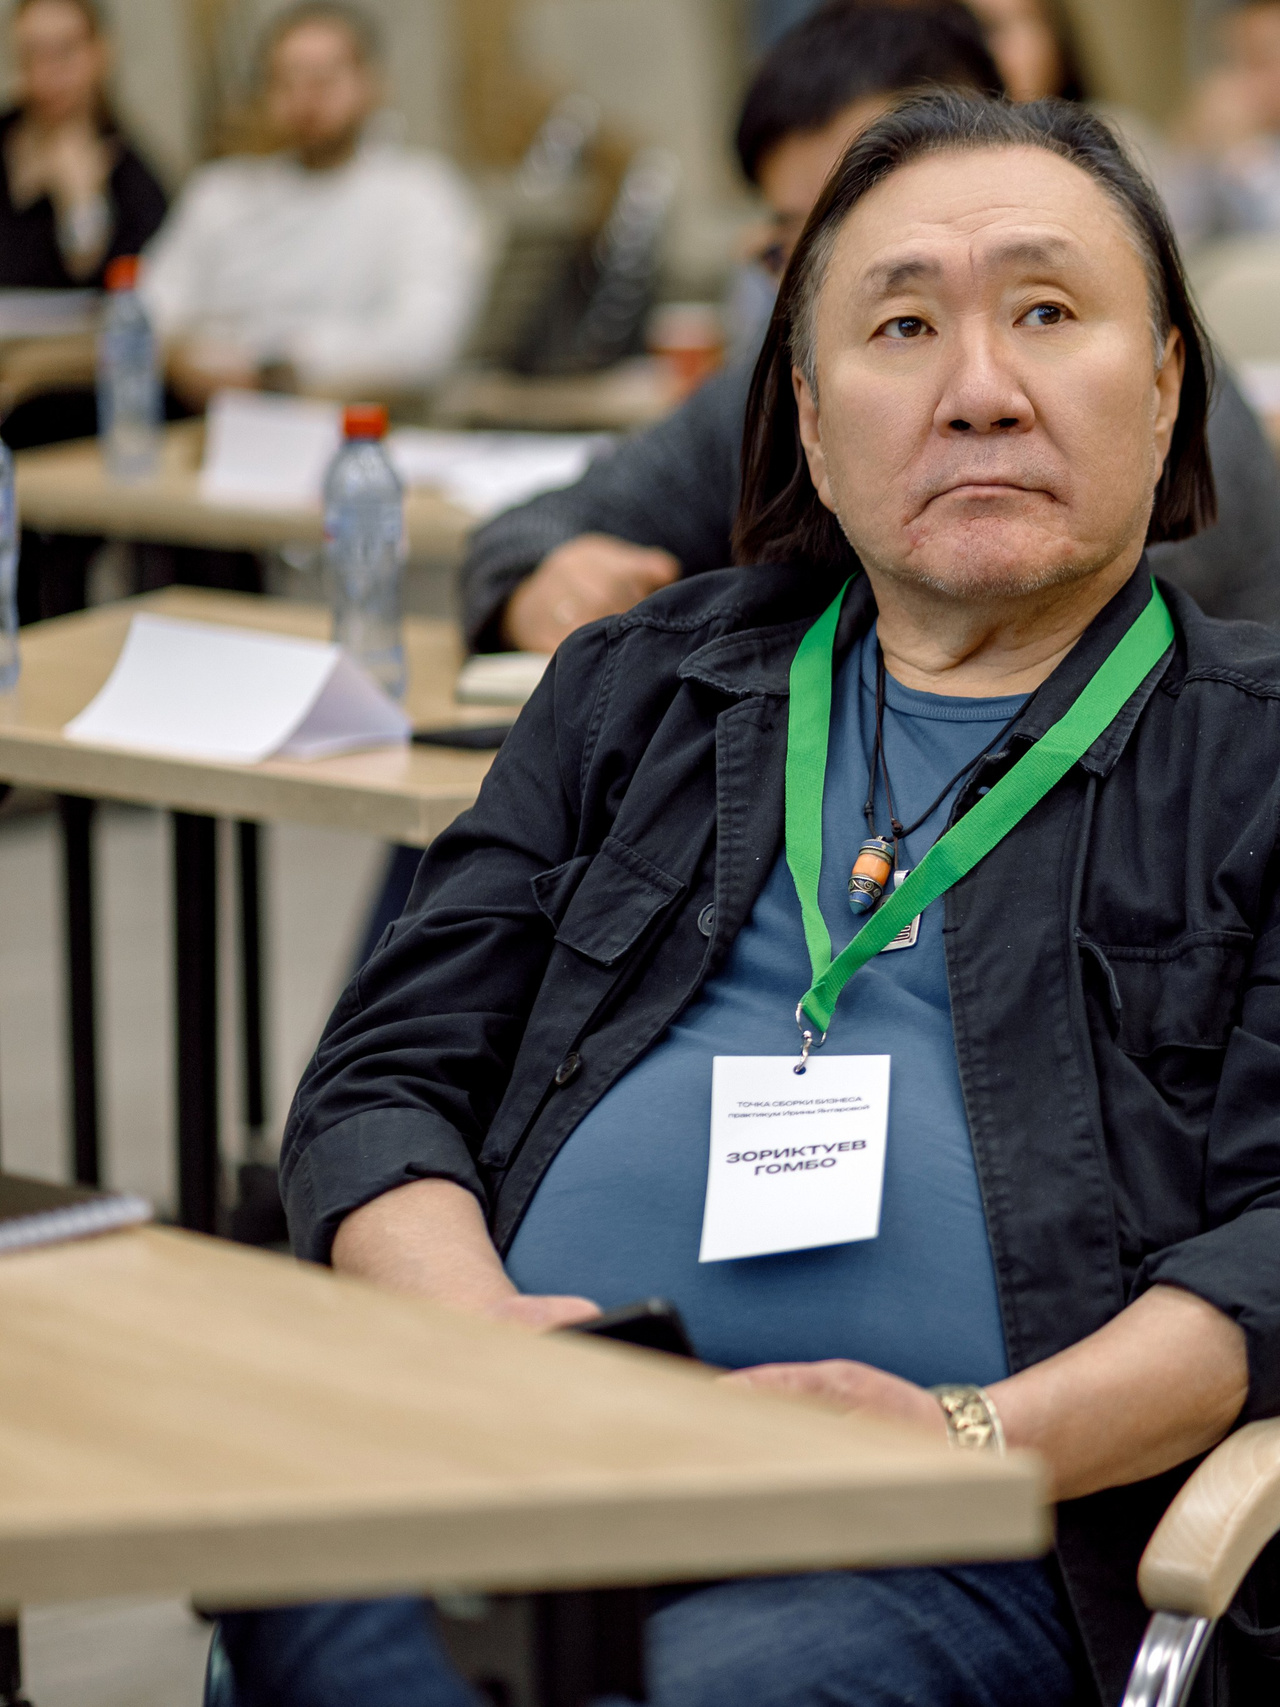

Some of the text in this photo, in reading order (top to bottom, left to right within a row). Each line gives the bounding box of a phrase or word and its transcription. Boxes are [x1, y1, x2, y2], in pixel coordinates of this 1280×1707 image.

[772, 1099, 813, 1107] СБОРКИ
[815, 1096, 863, 1105] БИЗНЕСА
[782, 1109, 815, 1117] Ирины
[726, 1139, 867, 1164] ЗОРИКТУЕВ
[754, 1157, 837, 1176] ГОМБО
